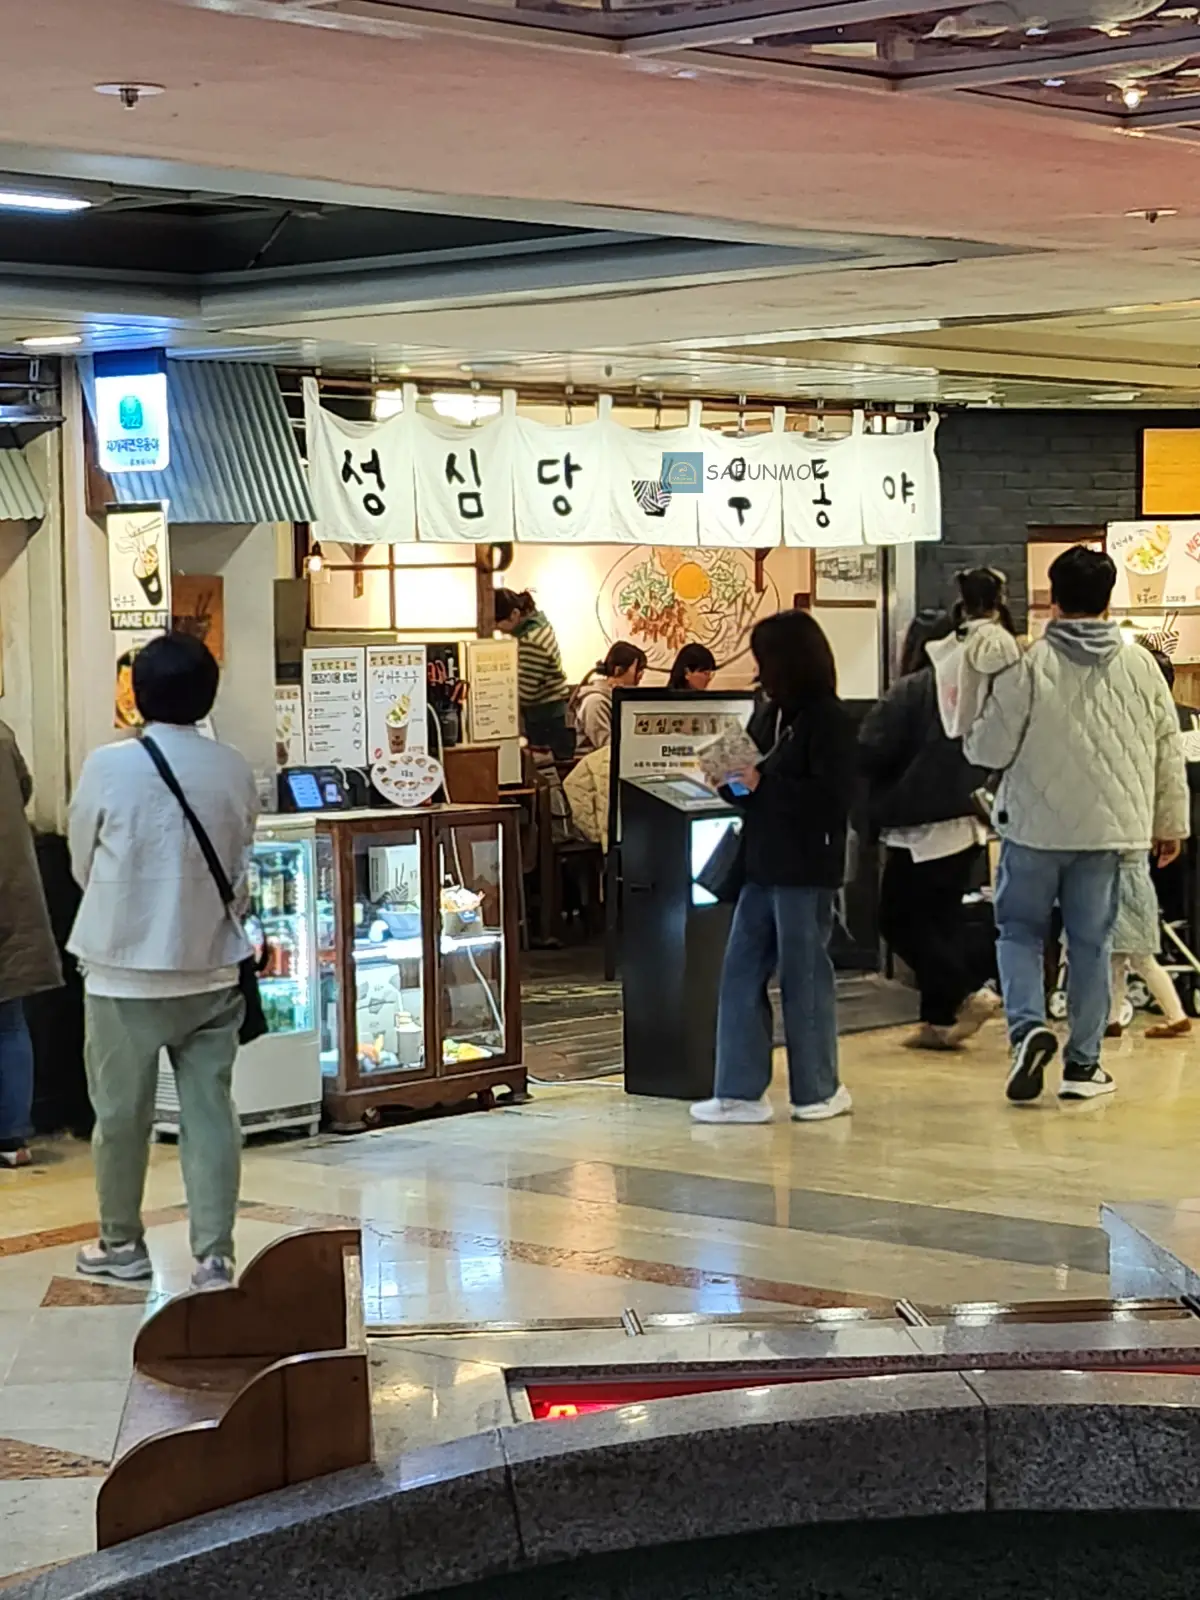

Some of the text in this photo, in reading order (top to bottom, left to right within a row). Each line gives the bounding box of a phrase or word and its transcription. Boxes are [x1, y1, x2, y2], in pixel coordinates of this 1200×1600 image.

[342, 448, 583, 519] 성심당
[111, 610, 167, 629] TAKE OUT
